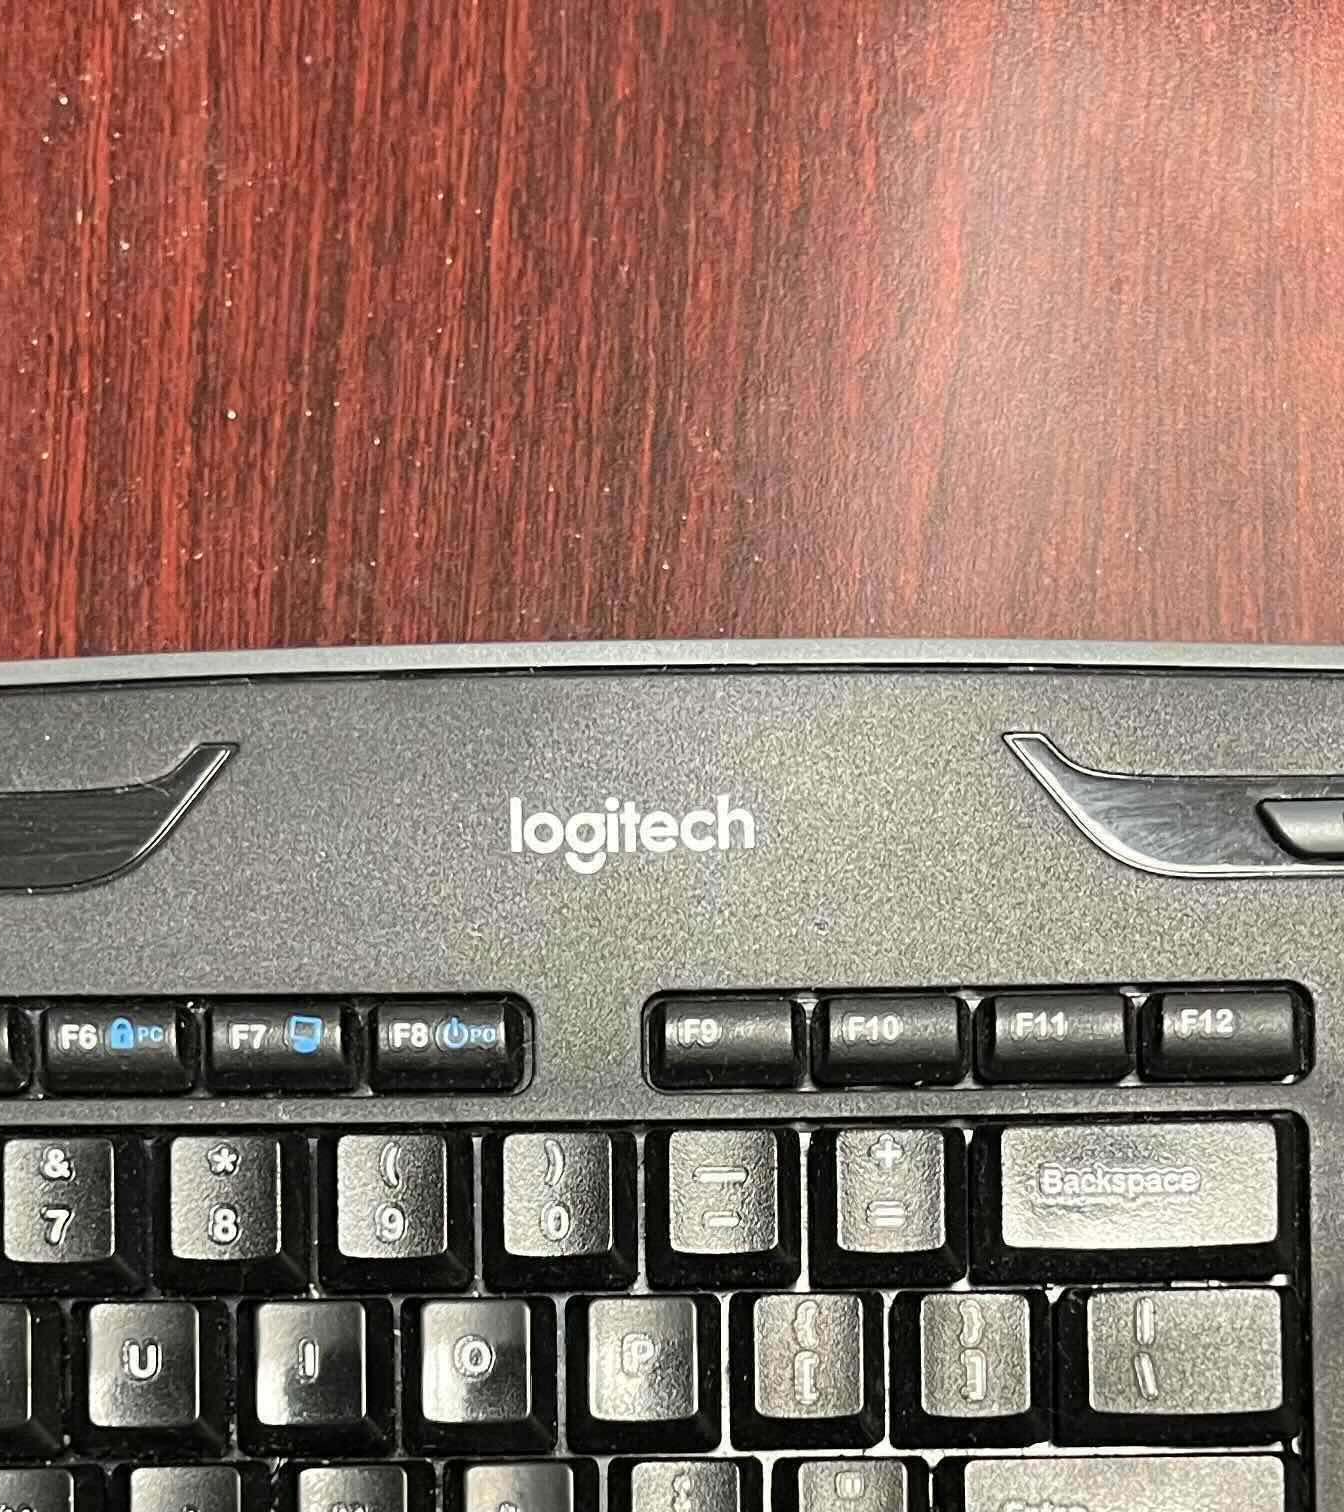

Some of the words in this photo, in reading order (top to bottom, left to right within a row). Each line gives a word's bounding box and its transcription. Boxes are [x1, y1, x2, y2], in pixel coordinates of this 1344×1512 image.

[509, 795, 755, 875] logitech
[62, 1024, 96, 1050] F6
[231, 1024, 265, 1050] F7
[393, 1022, 429, 1048] F8
[684, 1019, 719, 1042] F9
[848, 1015, 900, 1042] F10
[1016, 1013, 1065, 1037] F11
[1181, 1010, 1233, 1034] F12
[43, 1149, 72, 1180] &
[872, 1136, 903, 1168] +
[1040, 1166, 1199, 1198] Backspace
[44, 1210, 69, 1243] 7
[210, 1209, 237, 1241] 8
[382, 1206, 404, 1240] 9
[544, 1203, 570, 1240] 0
[127, 1342, 159, 1377] U
[301, 1342, 318, 1378] I
[455, 1336, 495, 1378] O
[625, 1334, 655, 1374] P
